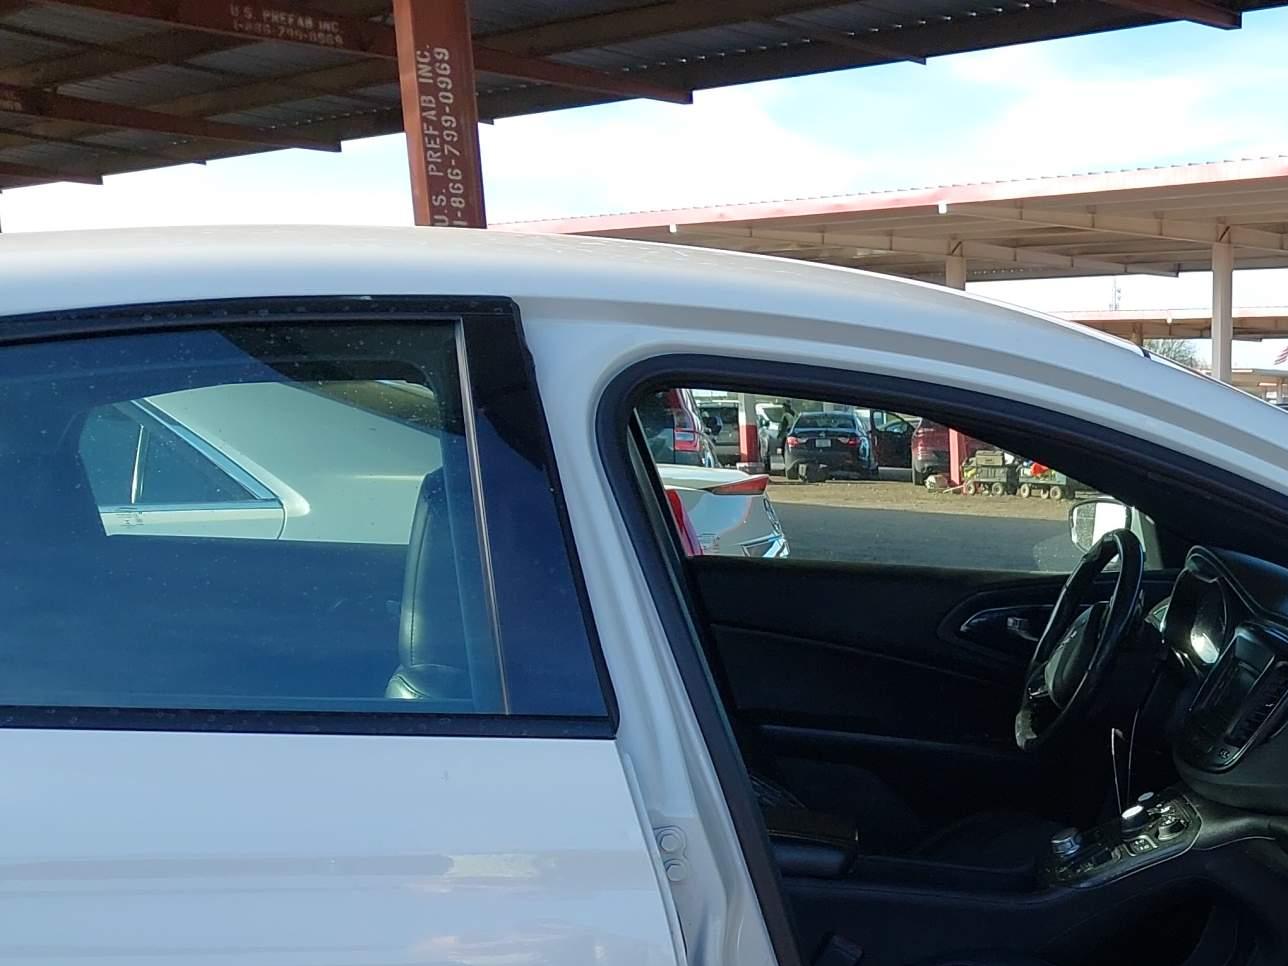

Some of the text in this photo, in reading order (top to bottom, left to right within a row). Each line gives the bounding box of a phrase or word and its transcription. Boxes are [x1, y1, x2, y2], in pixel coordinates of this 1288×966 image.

[416, 44, 449, 227] U.S. PREFAB INC.
[434, 47, 468, 226] 1-866-799-0969
